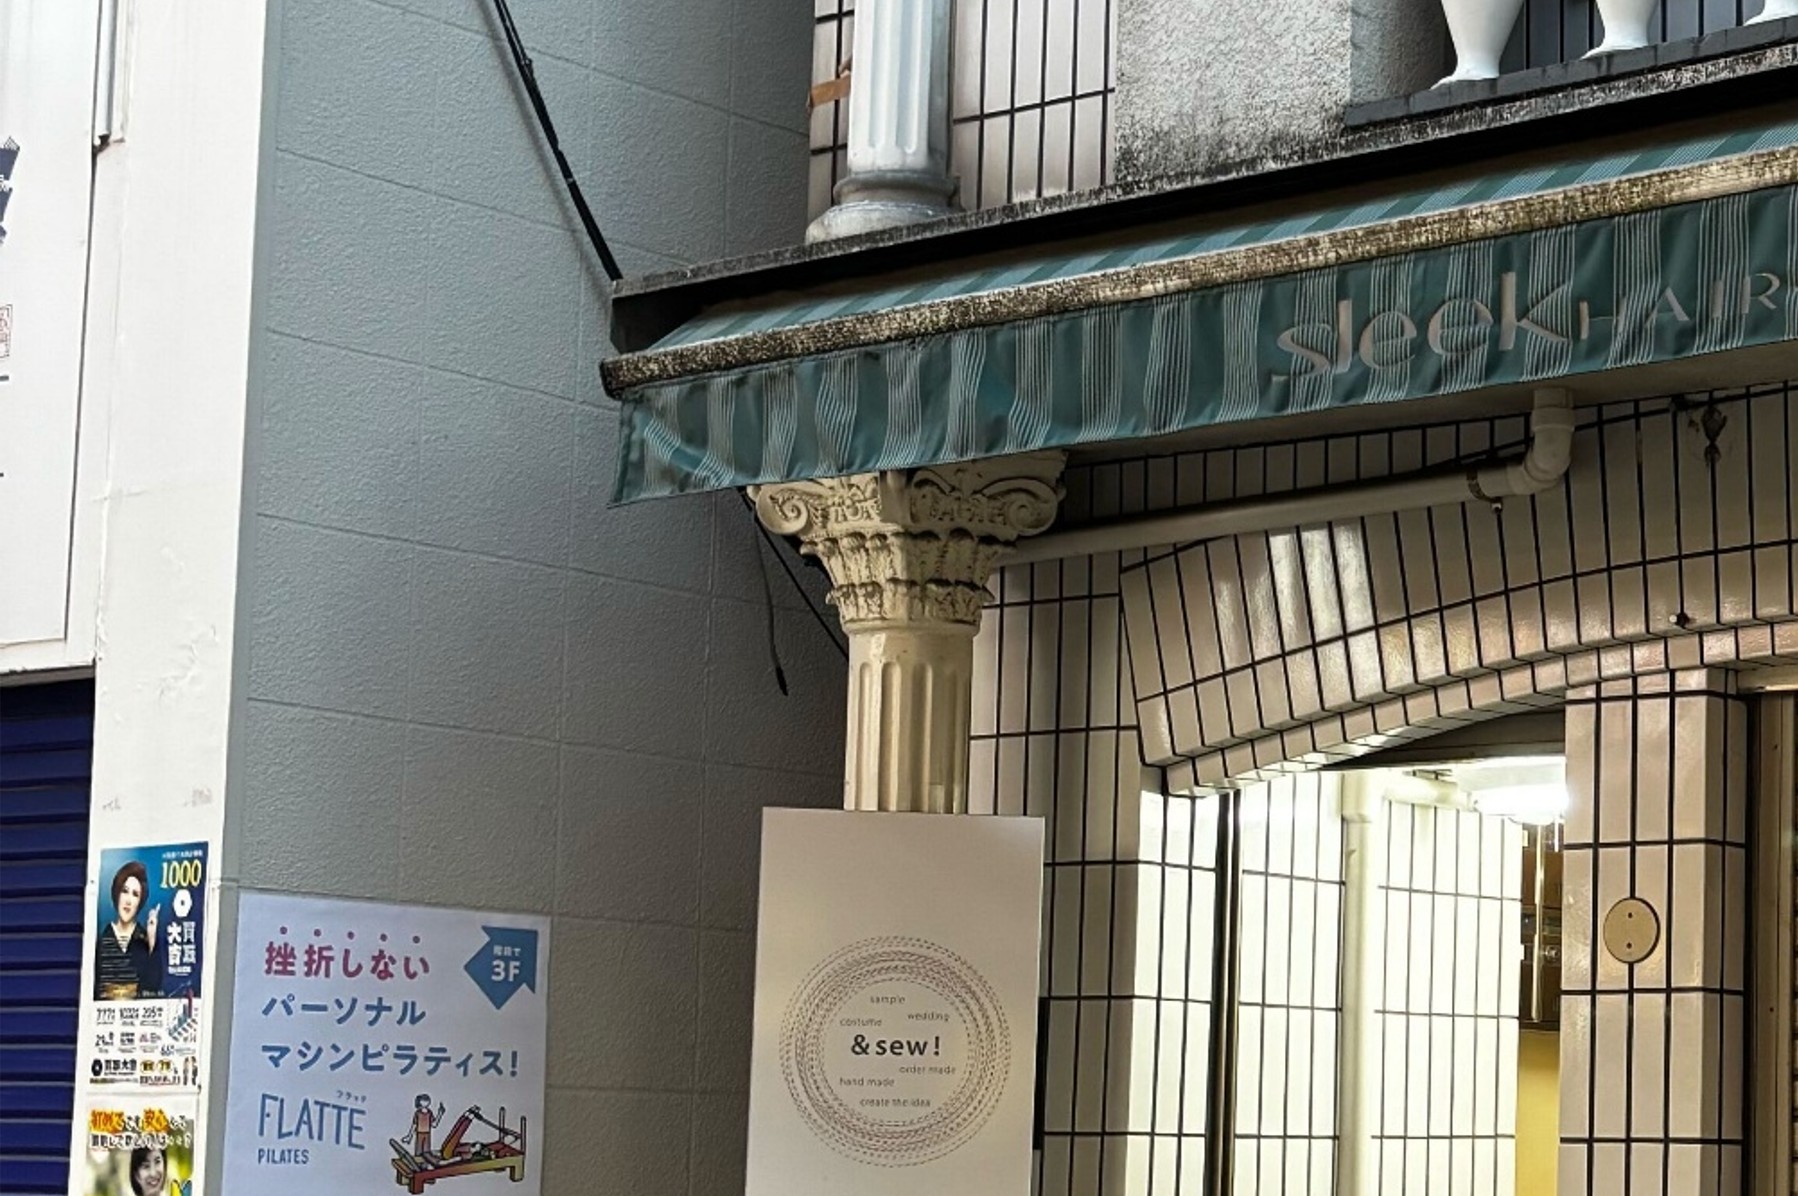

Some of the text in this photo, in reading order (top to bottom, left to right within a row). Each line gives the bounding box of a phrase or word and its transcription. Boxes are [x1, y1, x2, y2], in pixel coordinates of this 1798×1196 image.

[1579, 271, 1782, 341] HAIR
[160, 859, 202, 889] 1000
[264, 940, 430, 981] 挫折しない
[491, 960, 521, 982] 3F
[870, 995, 906, 1005] sample
[262, 993, 426, 1026] パーソナル
[907, 1011, 951, 1022] wedding
[840, 1018, 882, 1027] costume
[899, 1065, 957, 1075] order made
[839, 1077, 895, 1087] hand made
[859, 1098, 931, 1107] create the idea
[258, 1093, 367, 1150] FLATTE
[258, 1148, 310, 1165] PILATES
